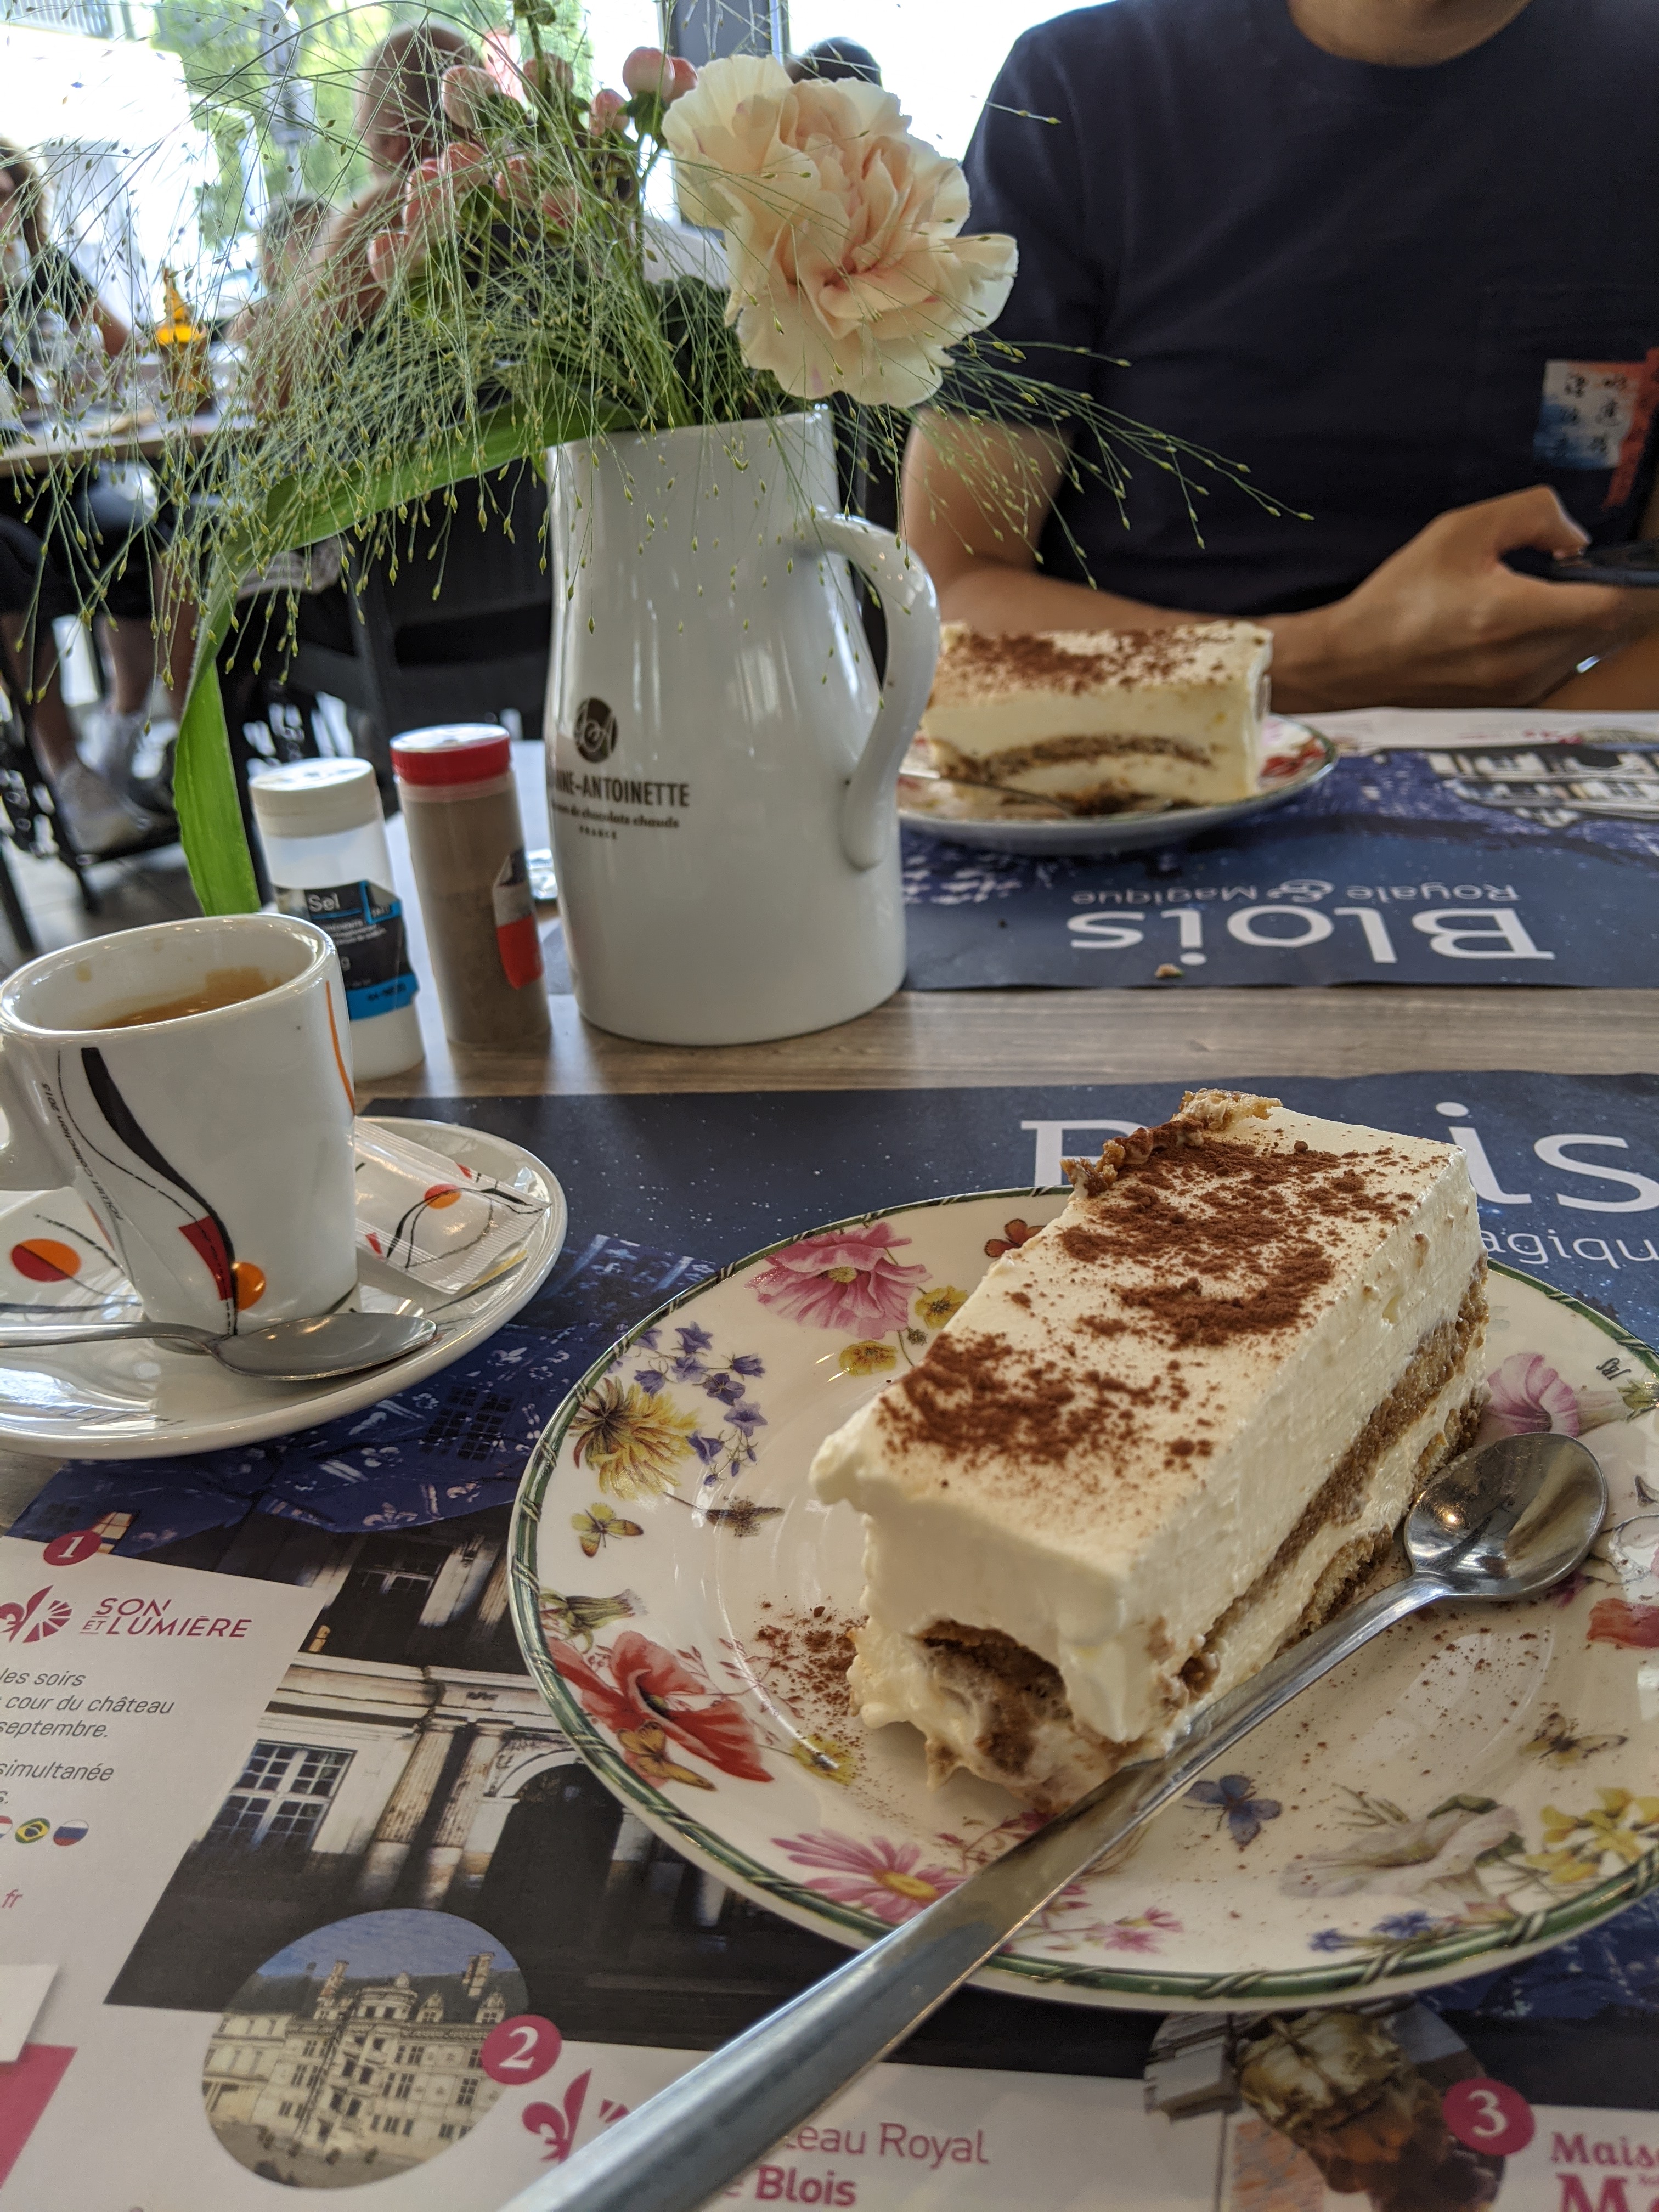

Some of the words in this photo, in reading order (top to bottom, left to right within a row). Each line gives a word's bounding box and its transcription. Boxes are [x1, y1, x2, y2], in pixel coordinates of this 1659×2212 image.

[308, 892, 340, 913] Sel
[1071, 884, 1257, 905] Magique
[1346, 883, 1521, 902] Royale
[1066, 905, 1555, 966] Blois
[41, 1082, 60, 1111] 2015
[57, 1115, 93, 1178] Collection
[1480, 1228, 1659, 1269] agiqu
[58, 1536, 84, 1559] 1
[95, 1597, 172, 1617] SON
[83, 1620, 107, 1630] ET
[106, 1615, 253, 1638] LUMIÈRE
[0, 1668, 30, 1684] les
[34, 1671, 86, 1686] soirs
[5, 1696, 54, 1710] cour
[56, 1694, 84, 1711] du
[87, 1695, 175, 1714] château
[498, 2025, 538, 2070] 2
[1467, 2089, 1508, 2138] 3
[879, 2121, 990, 2170] Royal
[1550, 2131, 1659, 2168] Mais
[755, 2164, 856, 2207] Blois
